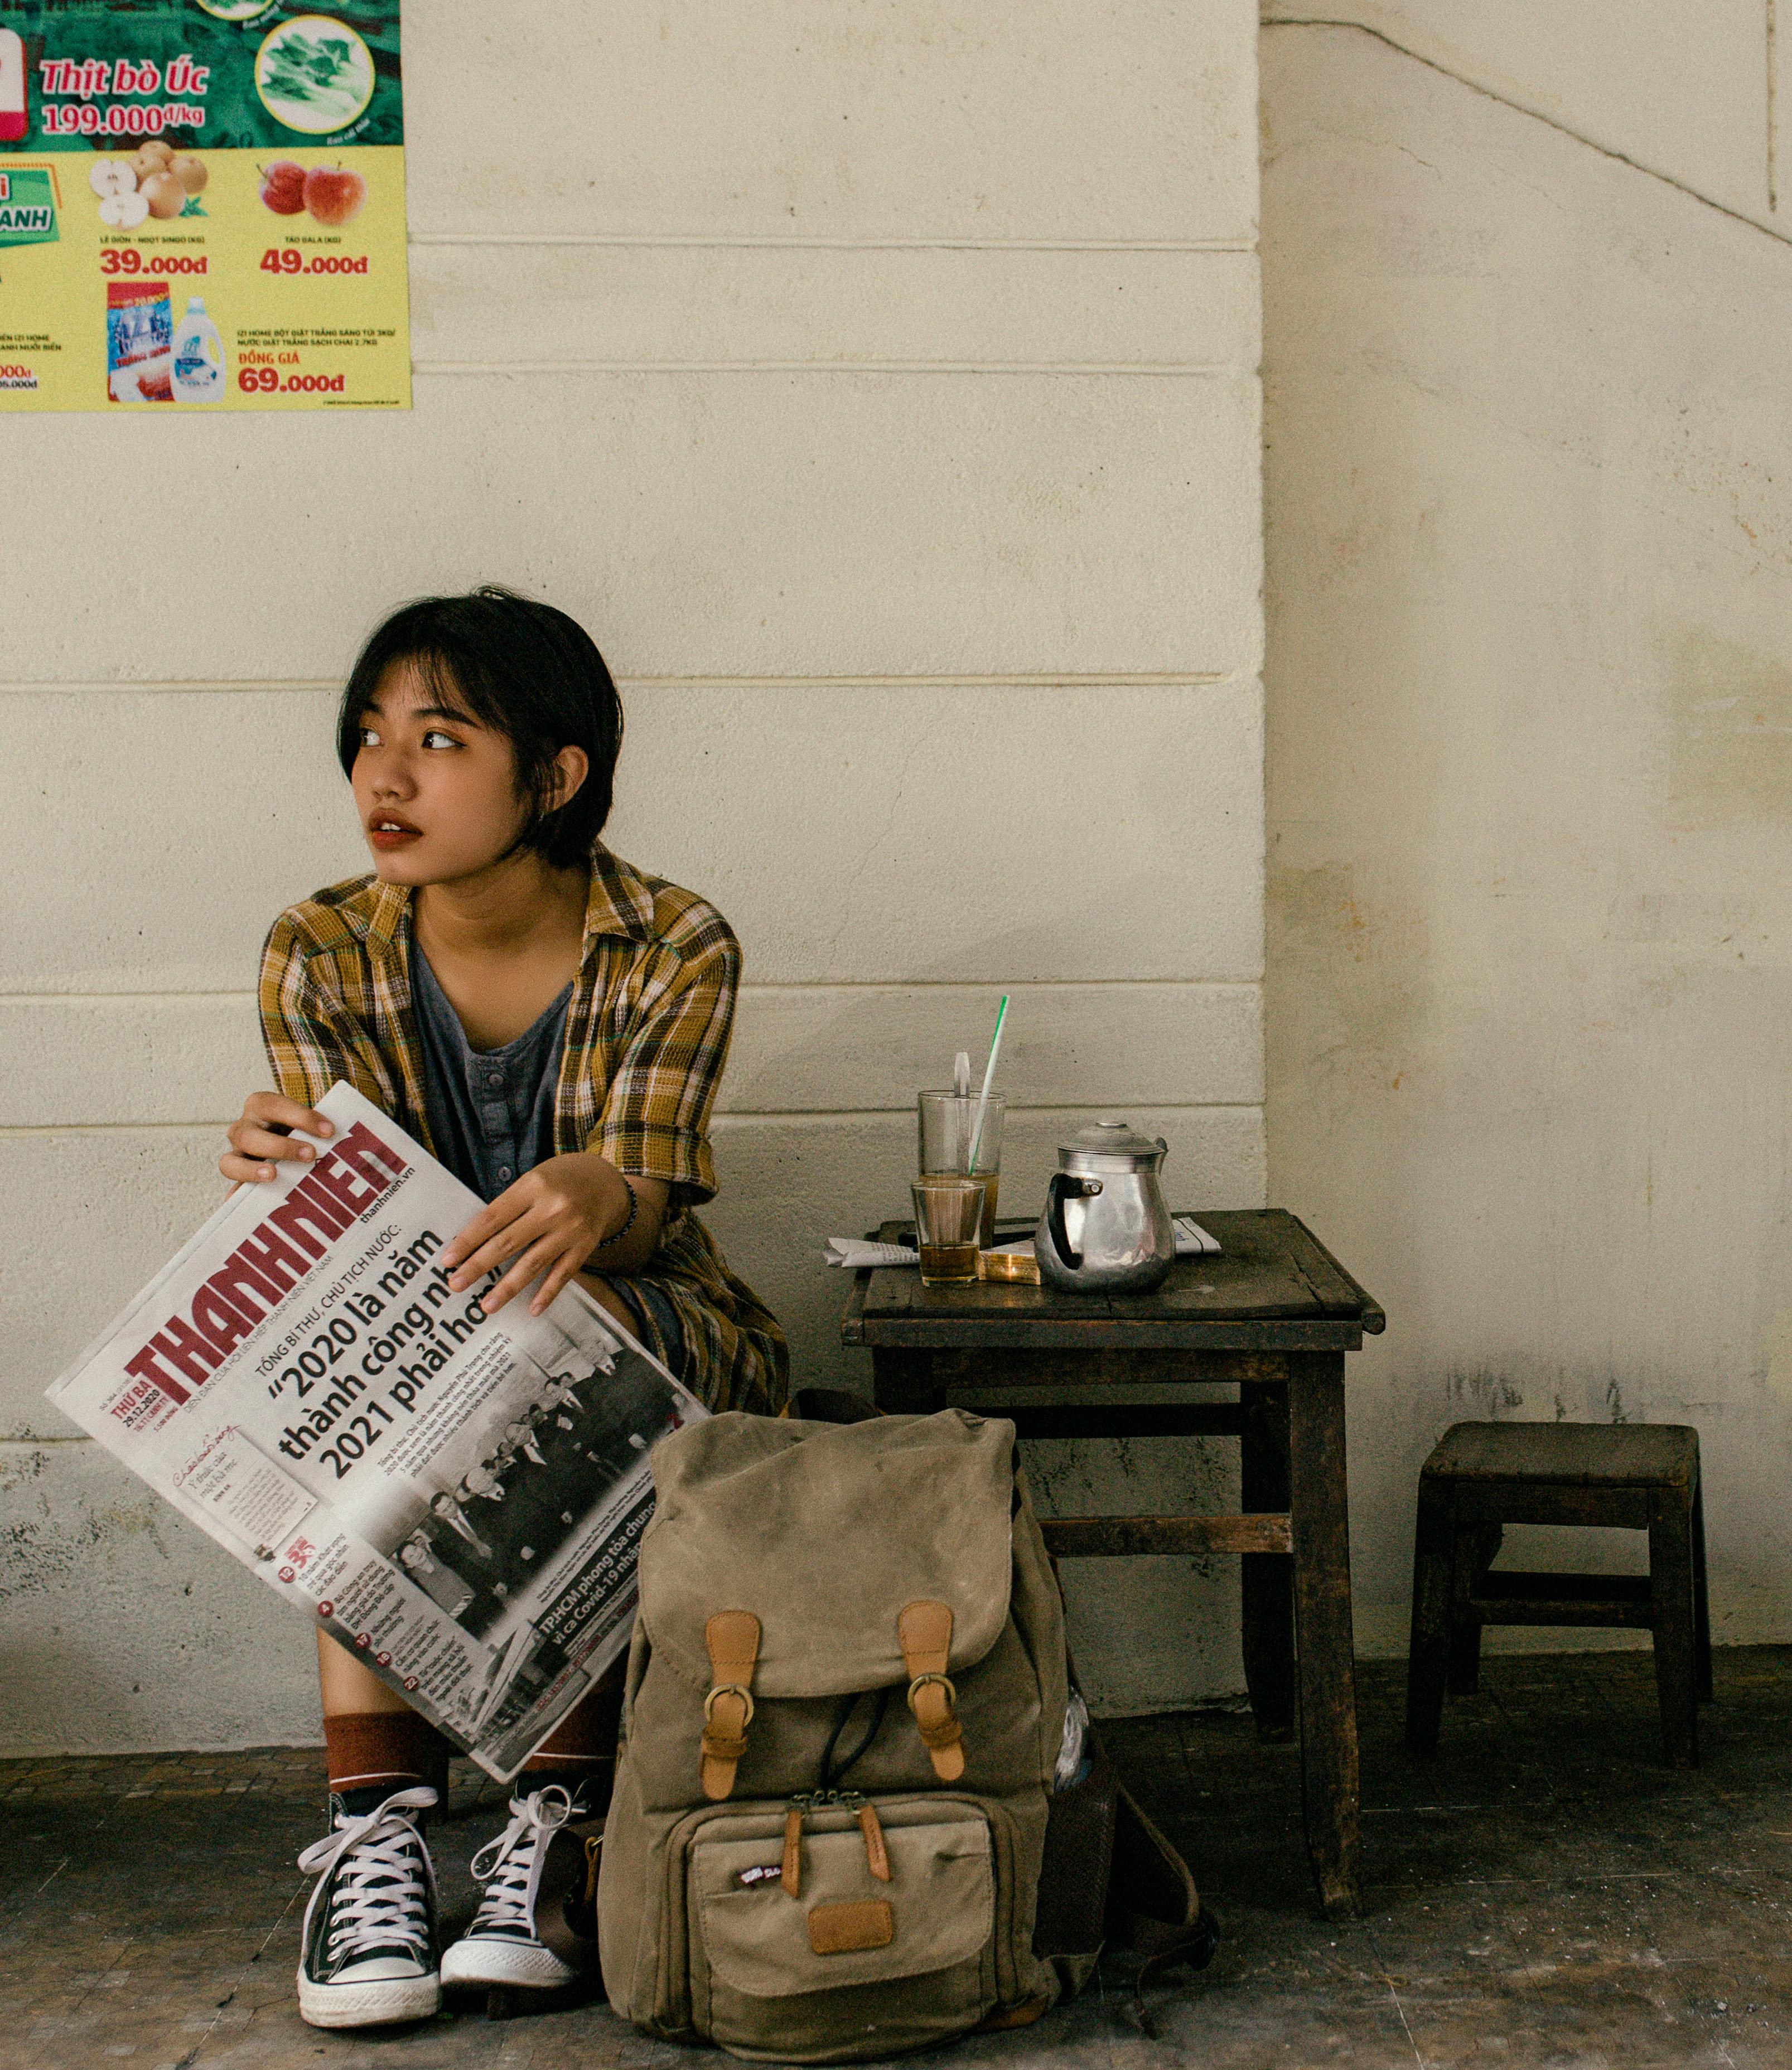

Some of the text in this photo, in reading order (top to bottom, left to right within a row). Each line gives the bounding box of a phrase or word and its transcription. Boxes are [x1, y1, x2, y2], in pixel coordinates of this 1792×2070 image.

[40, 55, 209, 99] Thịt bò Úc
[42, 103, 204, 134] 199.000đ/kg
[99, 249, 208, 274] 39.000đ
[260, 249, 368, 274] 49.000đ
[239, 350, 300, 365] ĐỒNG GIÁ
[238, 367, 345, 393] 69.000đ
[358, 1166, 416, 1223] thanhnien.vn
[254, 1223, 402, 1377] TỔNG BÍ THƯ, CHỦ TỊCH NƯỚC:
[265, 1300, 289, 1325] THANH
[286, 1284, 306, 1303] NIÊN
[315, 1254, 334, 1273] NAM
[267, 1227, 444, 1403] “2020 là năm
[109, 1379, 152, 1420] THỨ BA
[276, 1371, 368, 1461] thành
[358, 1300, 435, 1379] công
[122, 1389, 160, 1427] 29.12.2020
[318, 1400, 395, 1479] 2021
[385, 1329, 457, 1414] phải
[377, 1452, 393, 1467] Tổng
[405, 1424, 418, 1436] Chủ
[426, 1401, 440, 1415] nước
[455, 1369, 468, 1382] Phú
[480, 1344, 491, 1355] cho
[384, 1460, 399, 1476] 2020
[409, 1436, 422, 1449] xem
[424, 1418, 438, 1431] năm
[436, 1401, 453, 1419] thành
[451, 1388, 466, 1402] công
[474, 1360, 491, 1377] trong
[404, 1455, 417, 1468] năm
[416, 1444, 428, 1457] qua
[440, 1409, 460, 1428] không
[496, 1351, 511, 1366] 2021
[455, 1408, 474, 1426] thành
[279, 1566, 293, 1579] 12
[298, 1573, 308, 1581] 10
[538, 1589, 582, 1634] TP.HCM
[576, 1554, 615, 1595] phong
[606, 1534, 629, 1556] tỏa
[321, 1603, 330, 1613] 4
[552, 1569, 620, 1645] vì ca Covid-19
[356, 1633, 368, 1646] 17
[404, 1677, 417, 1689] 22
